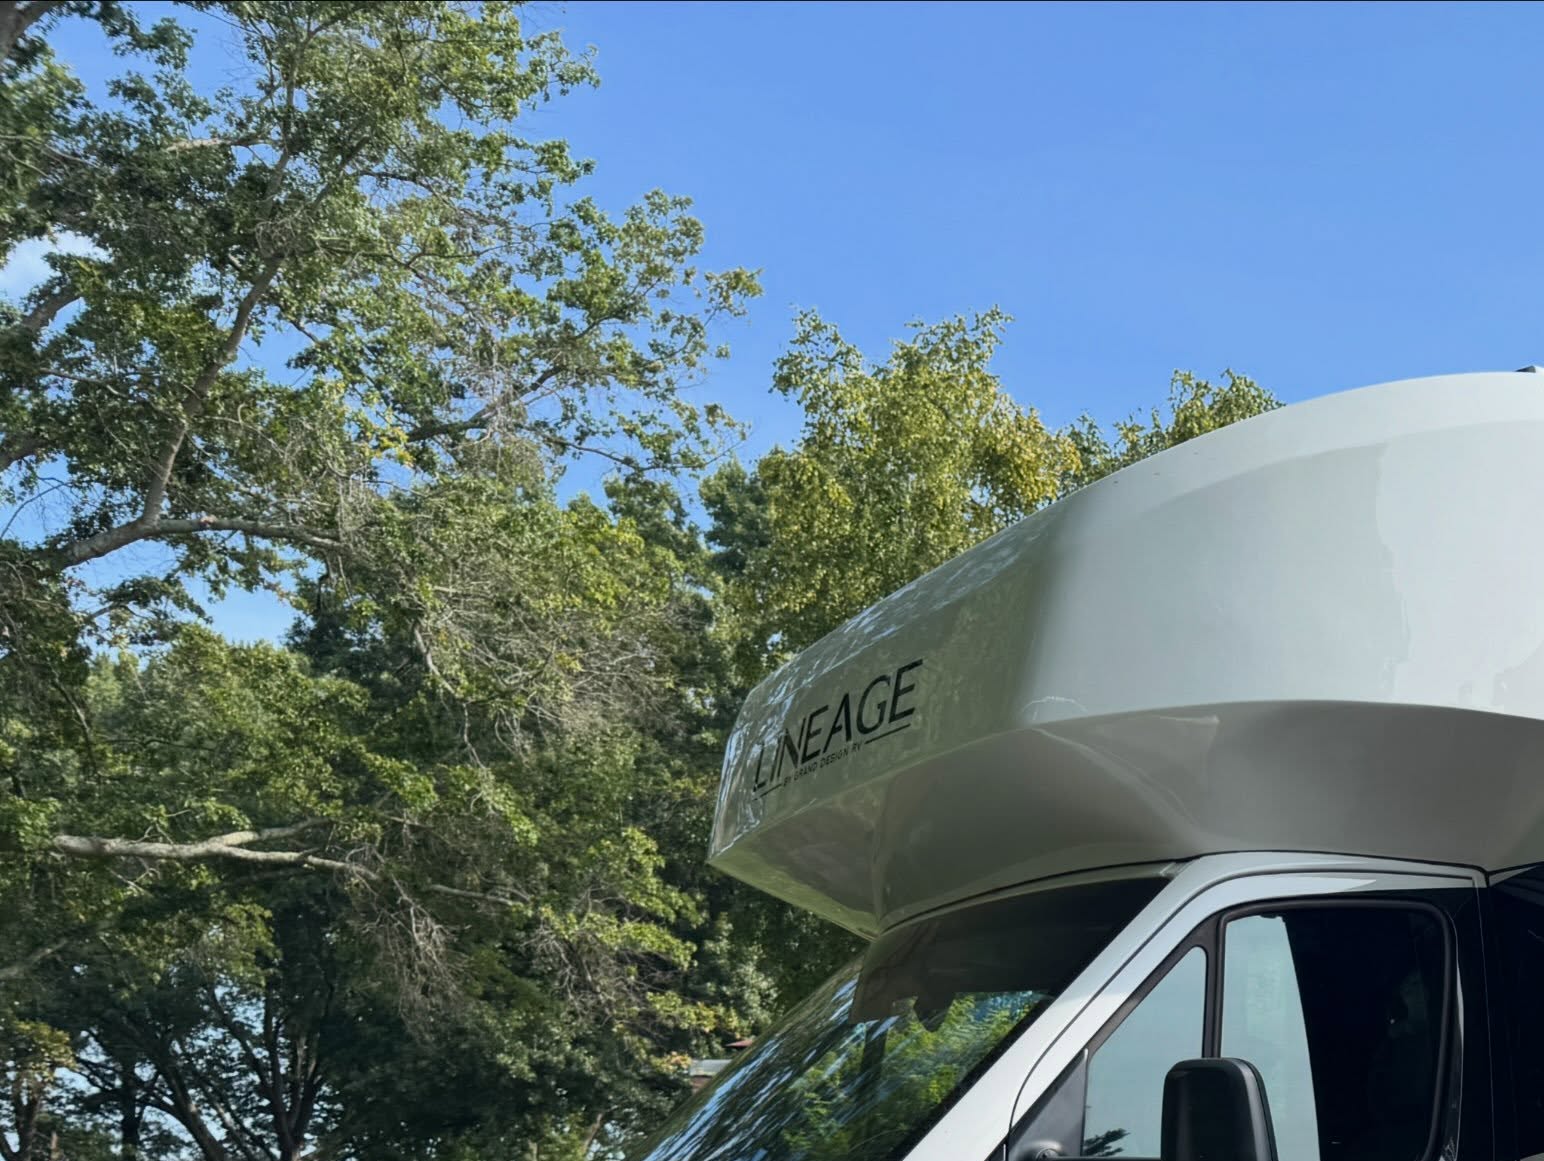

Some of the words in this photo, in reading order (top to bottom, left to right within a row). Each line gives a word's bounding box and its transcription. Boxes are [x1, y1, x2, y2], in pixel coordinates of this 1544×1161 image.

[753, 660, 923, 792] LINEAGE
[794, 762, 818, 780] GRAND
[819, 748, 849, 767] DESIGN
